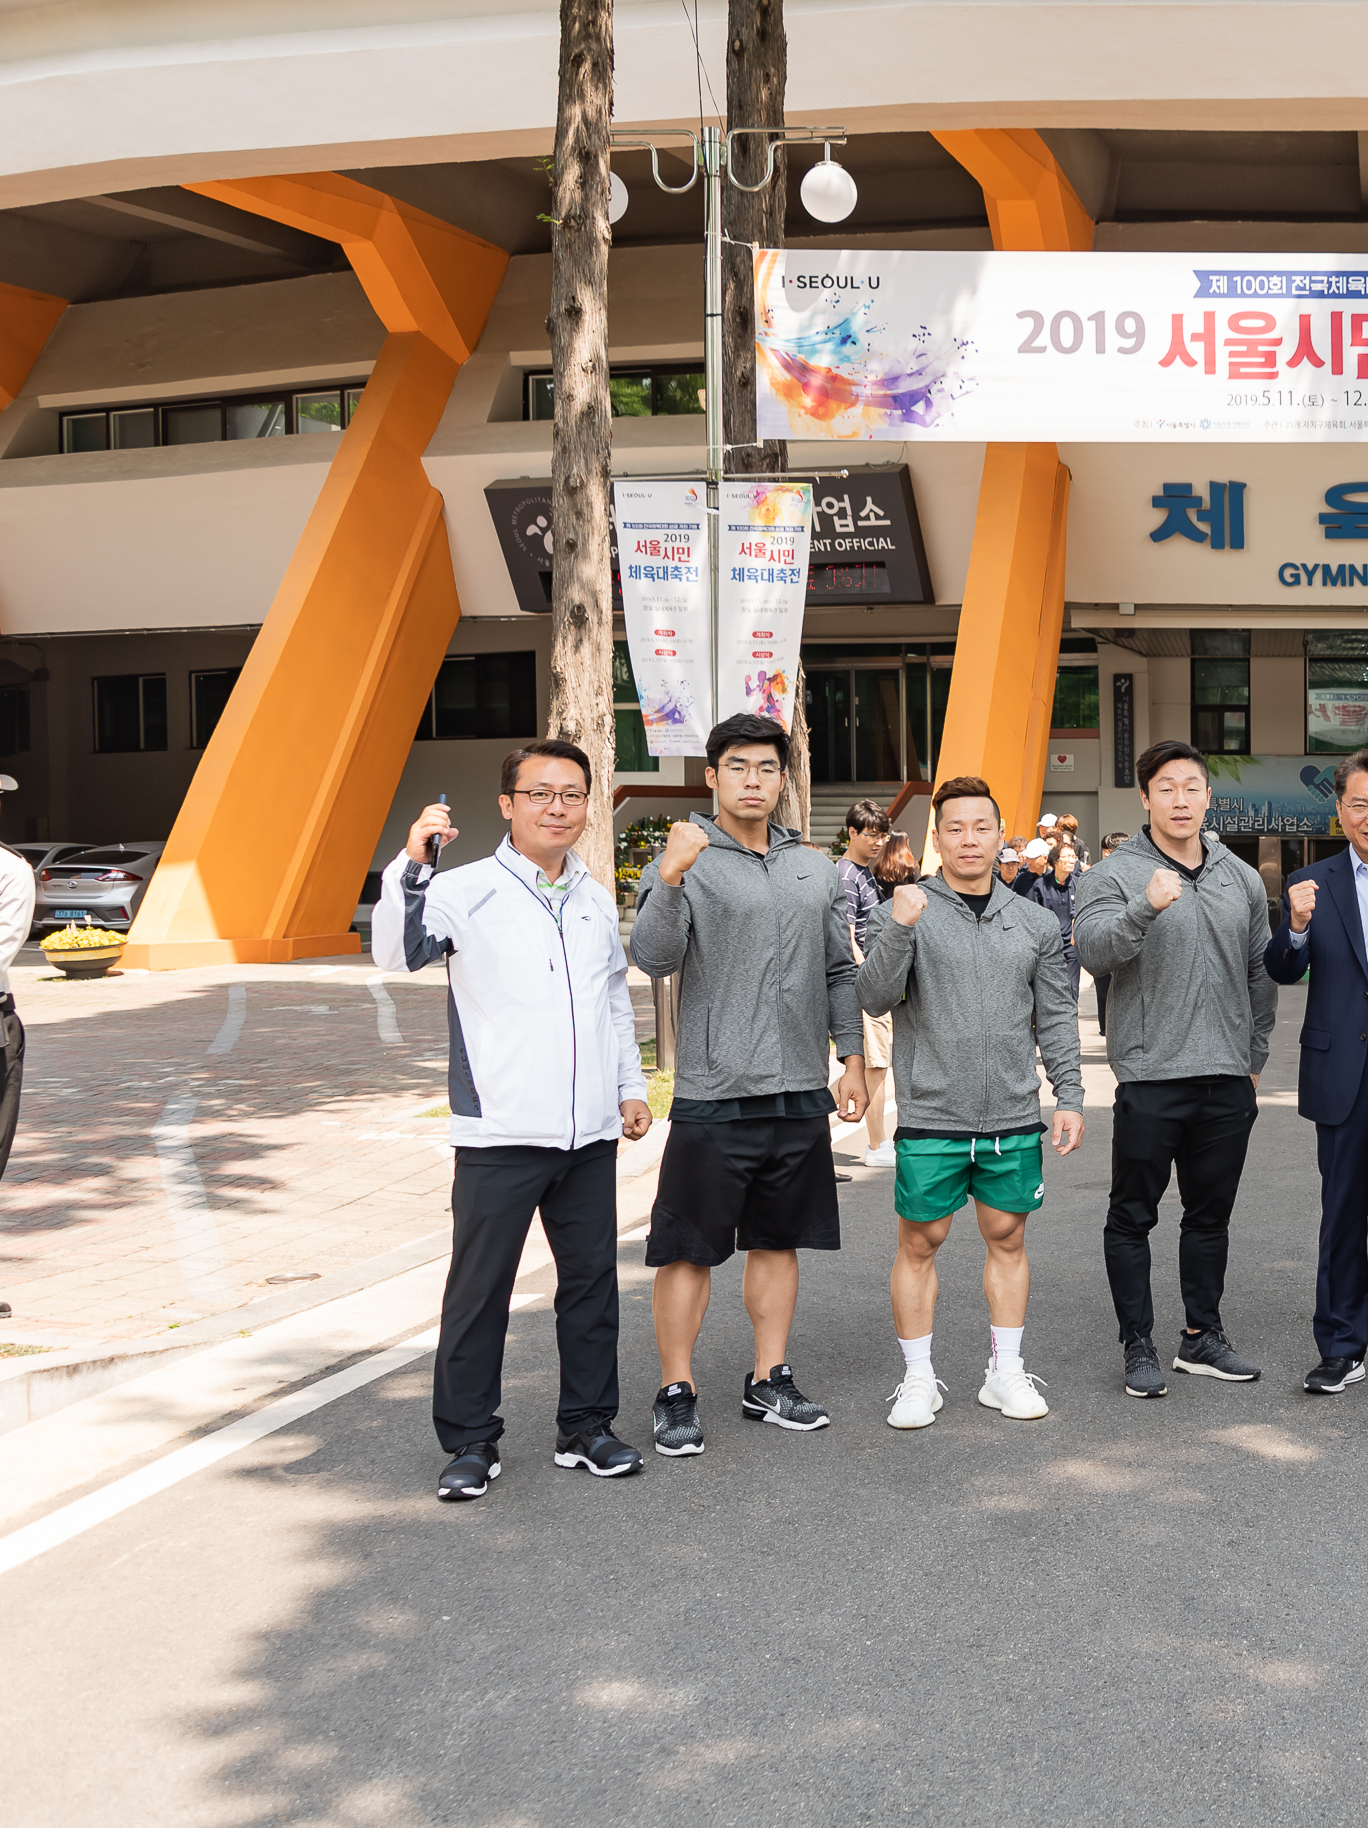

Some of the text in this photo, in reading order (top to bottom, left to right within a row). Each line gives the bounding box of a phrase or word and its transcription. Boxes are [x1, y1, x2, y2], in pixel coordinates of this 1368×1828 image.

[796, 273, 860, 289] SEOUL
[1208, 275, 1228, 295] 제
[1232, 275, 1287, 295] 100회
[1015, 309, 1147, 355] 2019
[664, 533, 690, 543] 2019
[770, 536, 795, 546] 2019
[834, 537, 896, 551] OFFICIAL
[628, 564, 698, 582] 체육대축전
[730, 567, 801, 584] 체육대축전
